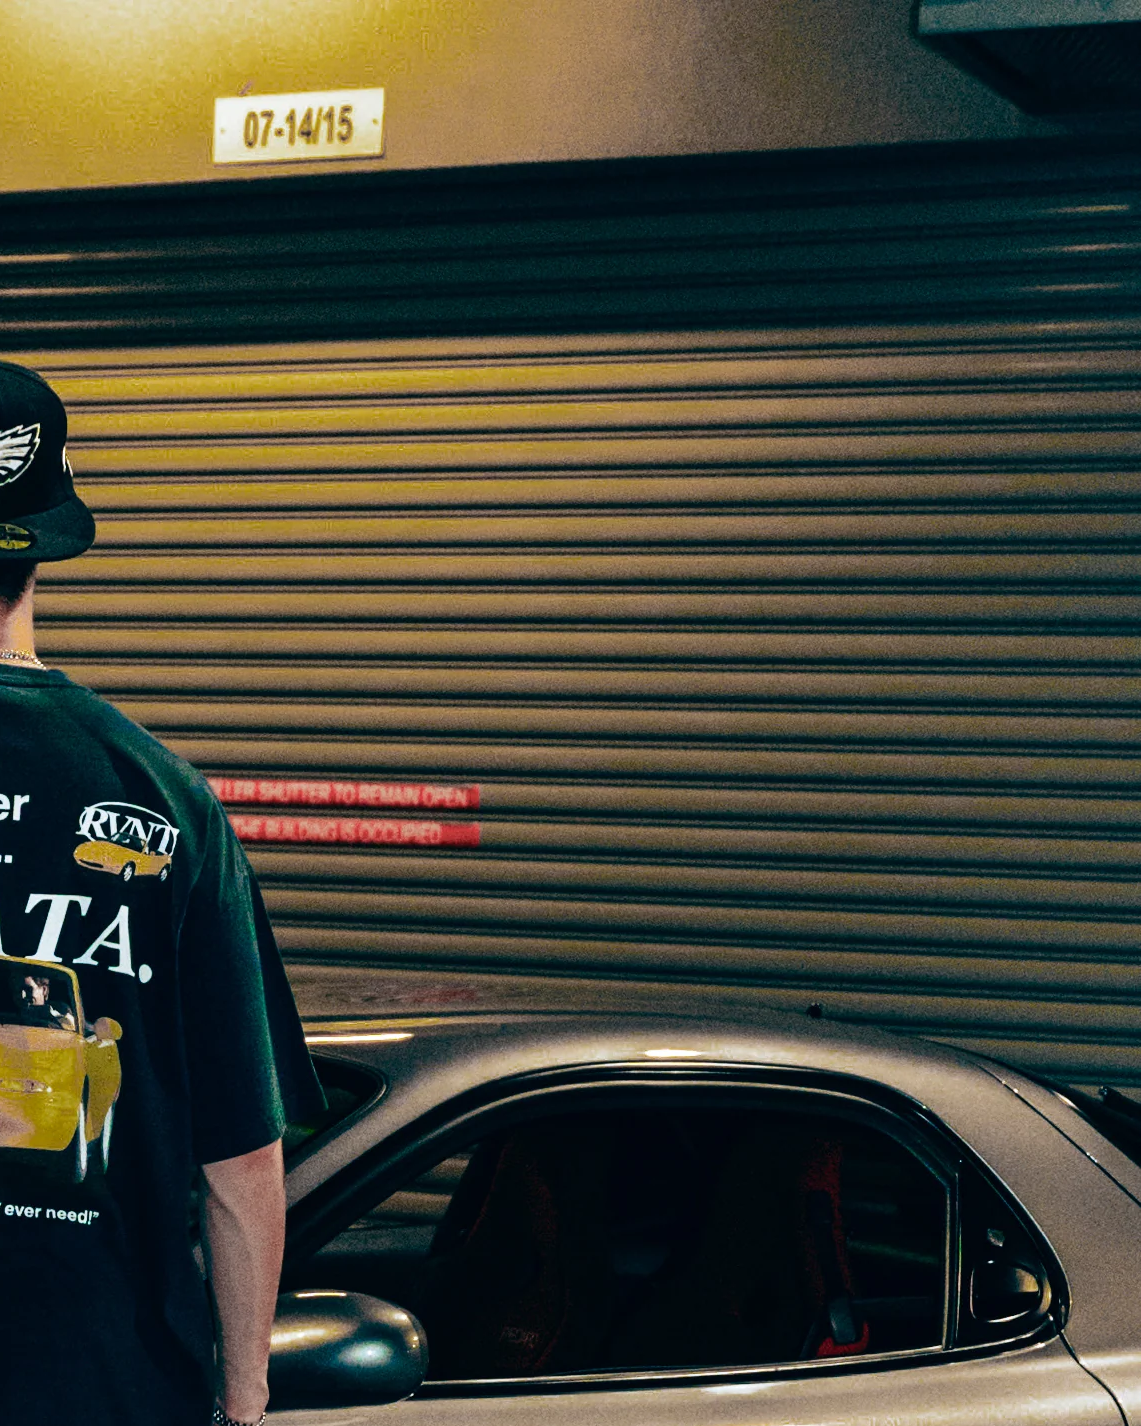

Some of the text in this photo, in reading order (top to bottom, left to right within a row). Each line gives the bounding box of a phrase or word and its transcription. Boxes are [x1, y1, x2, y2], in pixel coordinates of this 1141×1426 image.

[243, 105, 354, 148] 07-14/15
[333, 782, 355, 804] TO
[422, 785, 468, 807] OPEN
[75, 805, 180, 855] RVNT
[359, 821, 442, 844] OCCUPIED
[4, 1204, 42, 1218] ever
